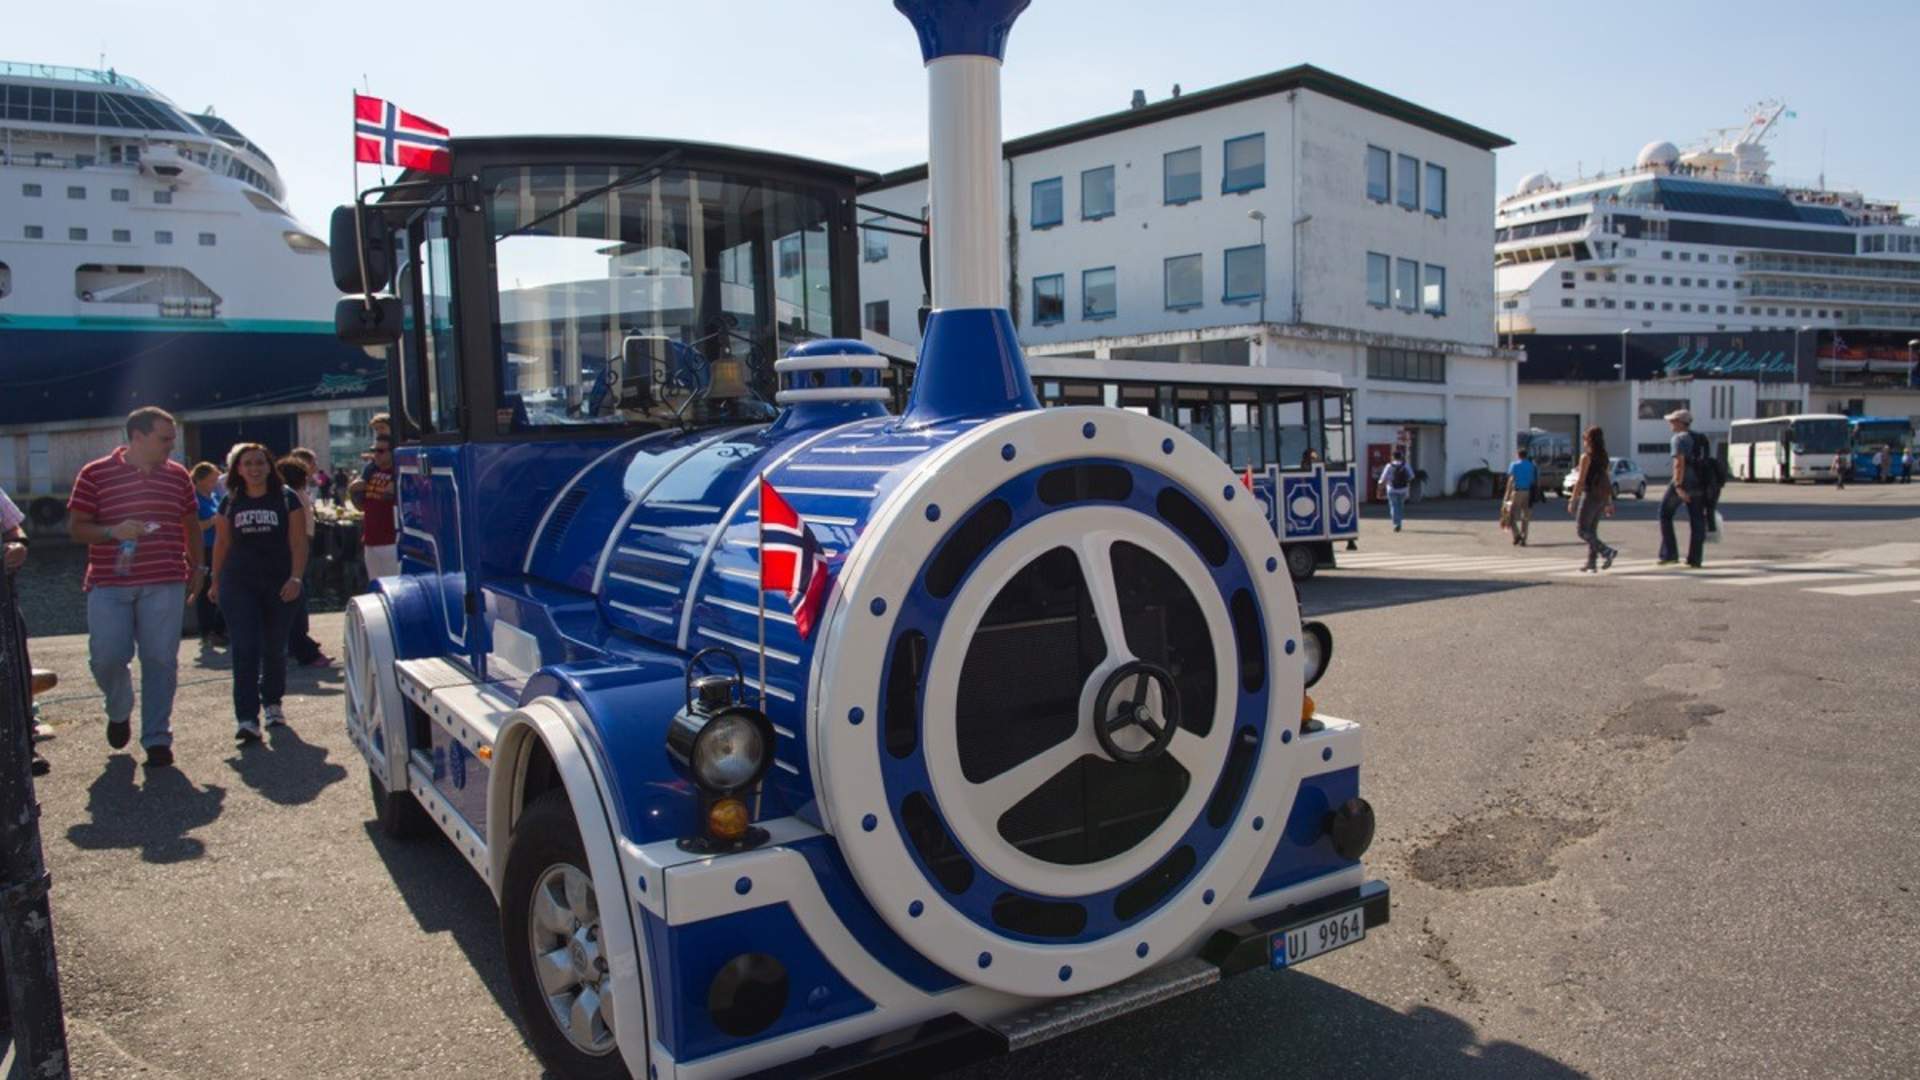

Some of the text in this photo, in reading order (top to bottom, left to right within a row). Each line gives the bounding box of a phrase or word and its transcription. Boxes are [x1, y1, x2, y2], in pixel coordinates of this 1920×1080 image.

[234, 509, 279, 528] OXFORD
[1288, 913, 1360, 959] UJ 9964
